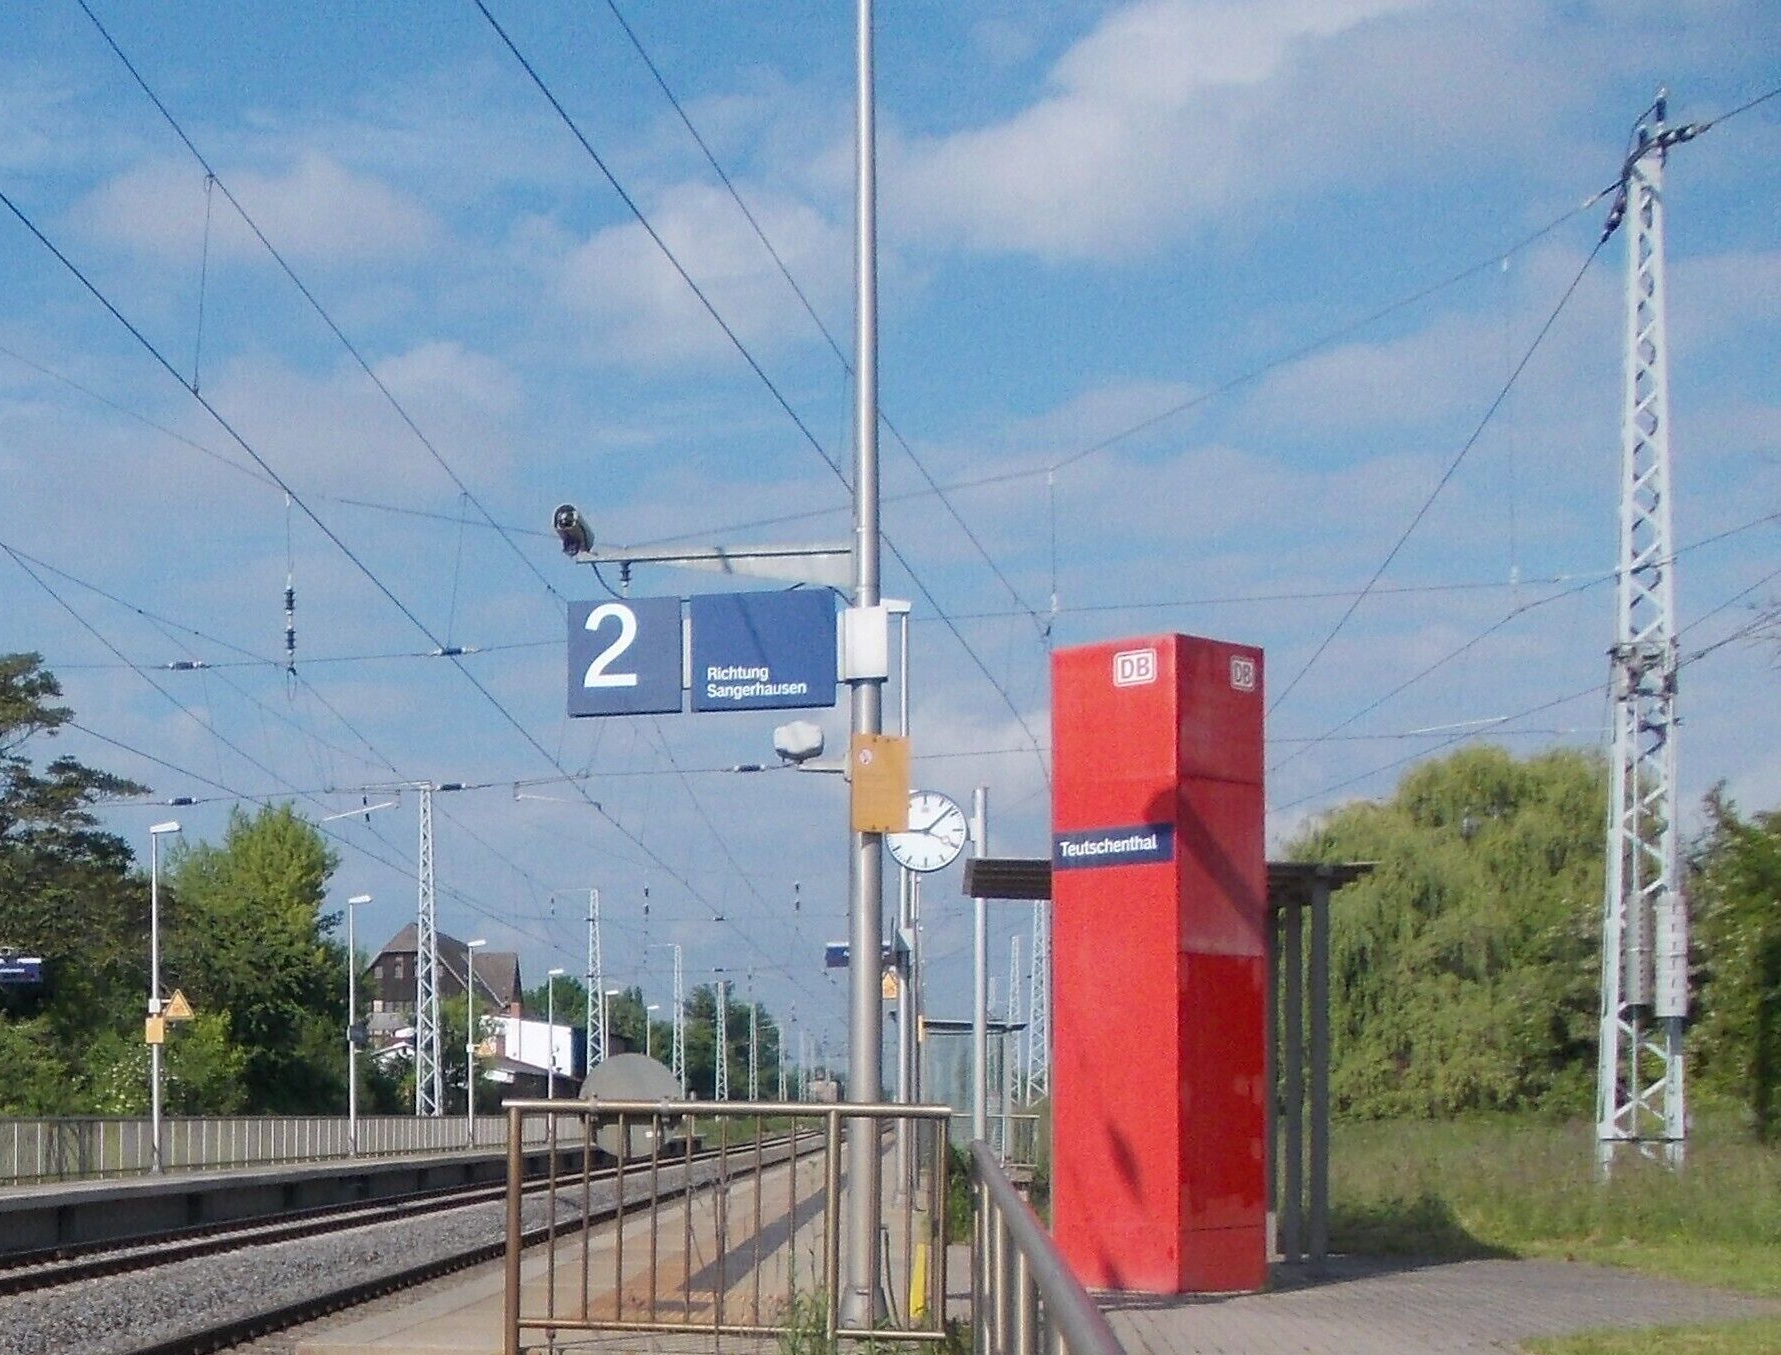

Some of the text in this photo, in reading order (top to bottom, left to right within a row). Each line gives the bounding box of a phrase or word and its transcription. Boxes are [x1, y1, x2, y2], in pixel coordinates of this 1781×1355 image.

[584, 603, 638, 688] 2
[707, 666, 769, 682] Richtung
[1120, 656, 1150, 679] DB
[1233, 662, 1252, 684] DB
[707, 682, 808, 700] Sangerhausen
[1059, 834, 1158, 857] Teutschenthal
